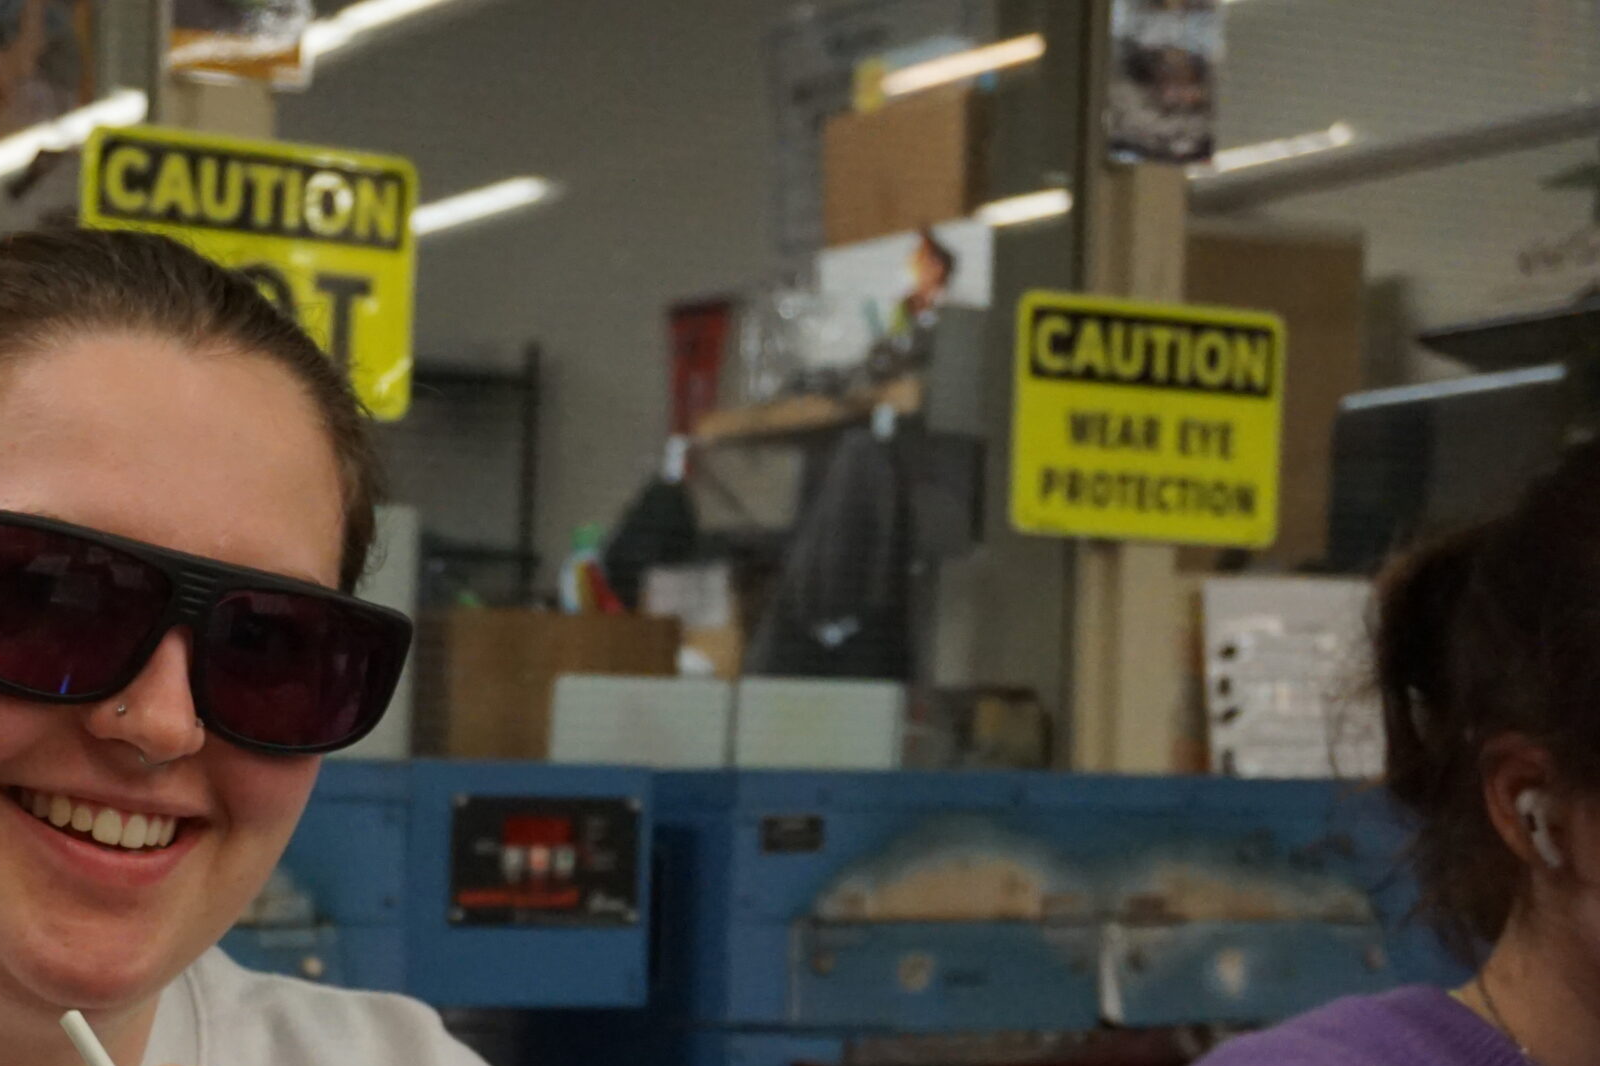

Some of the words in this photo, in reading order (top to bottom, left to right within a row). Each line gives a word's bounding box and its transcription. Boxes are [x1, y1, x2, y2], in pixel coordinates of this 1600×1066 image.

[104, 146, 398, 242] CAUTION
[1036, 314, 1269, 390] CAUTION
[1069, 411, 1160, 451] WEAR
[1178, 416, 1234, 461] EYE
[1038, 466, 1257, 519] PROTECTION
